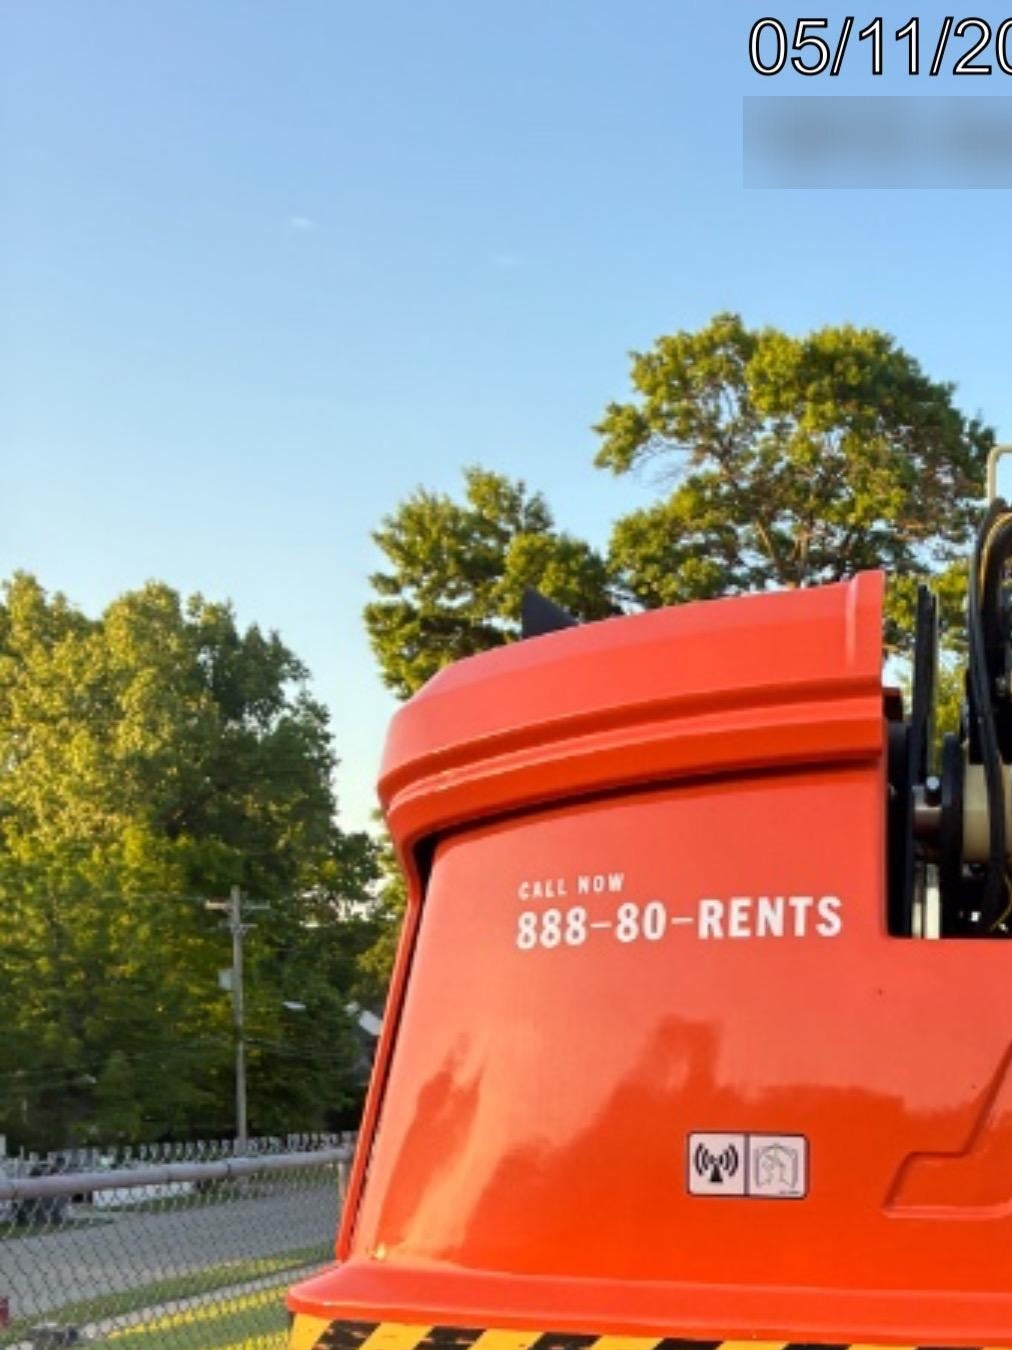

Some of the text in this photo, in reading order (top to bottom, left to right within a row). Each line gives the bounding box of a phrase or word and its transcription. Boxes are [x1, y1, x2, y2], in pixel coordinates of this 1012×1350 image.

[517, 872, 625, 901] CALL NOW
[516, 895, 844, 950] 888-80-RENTS
